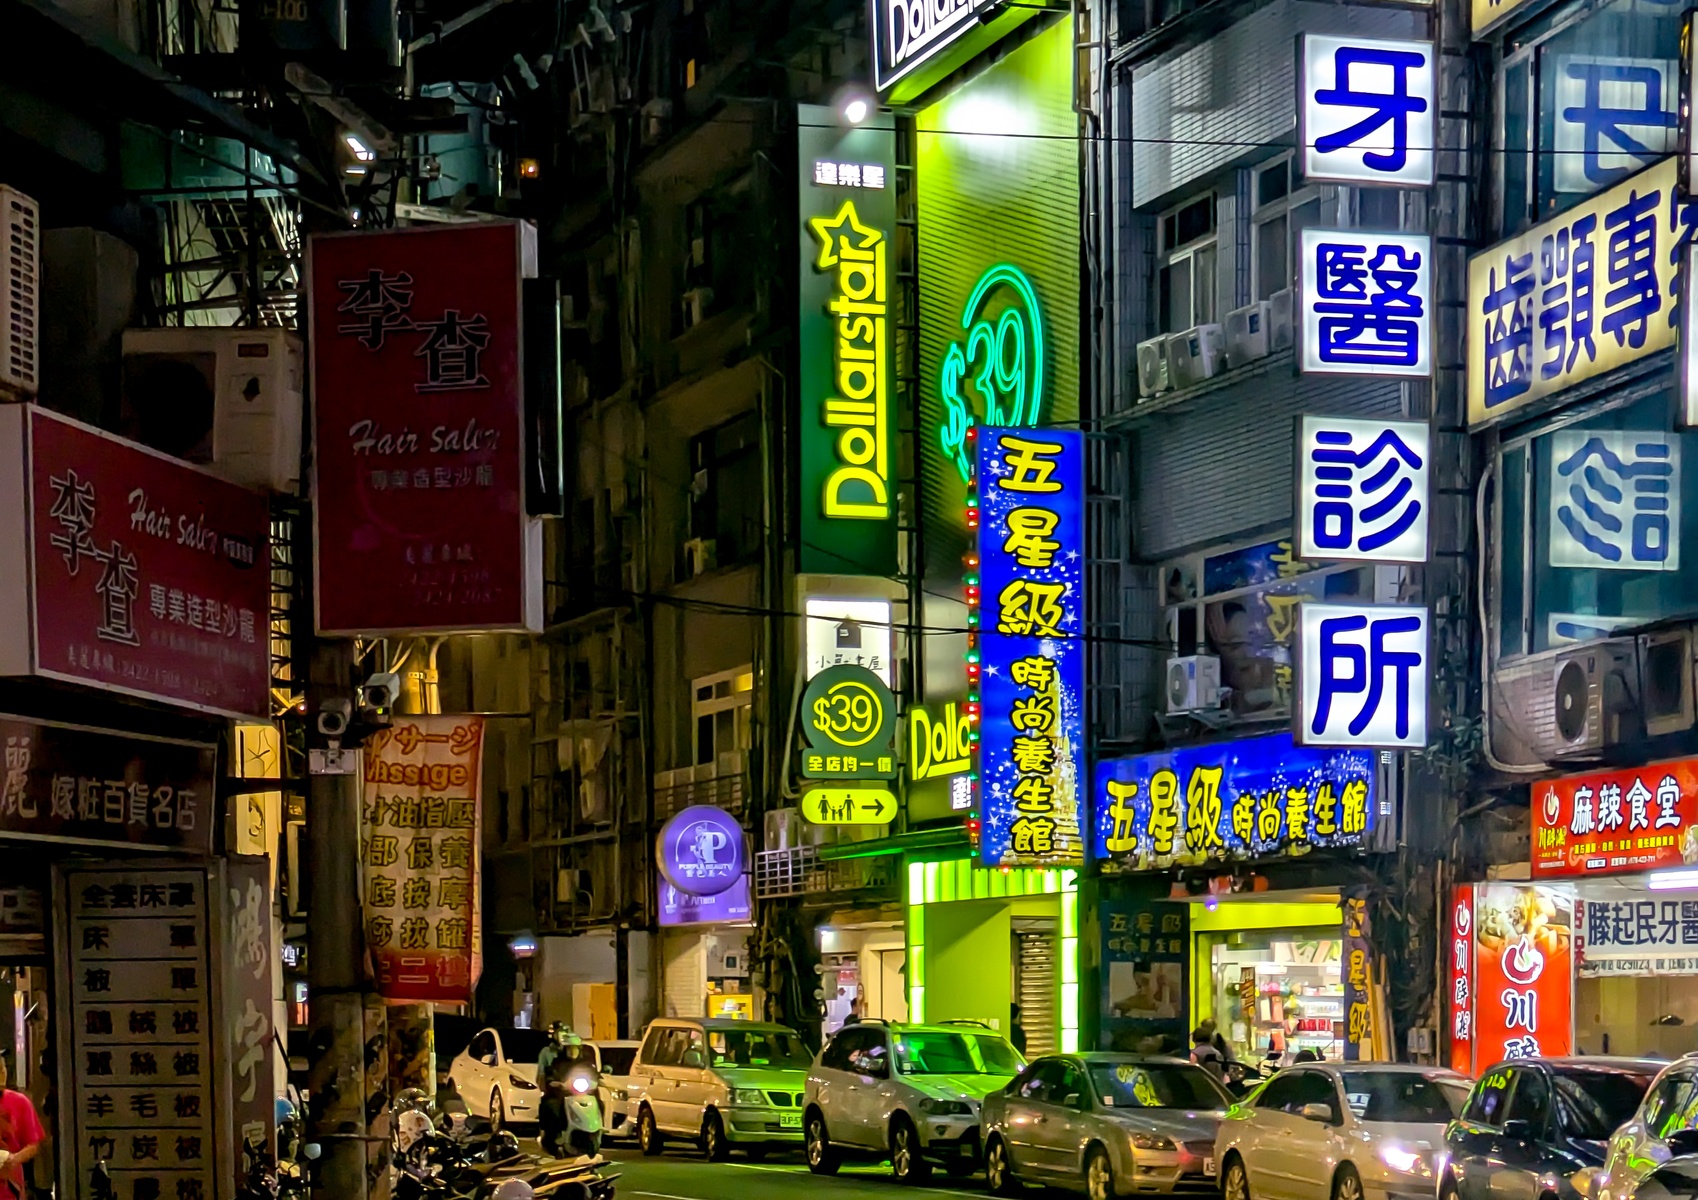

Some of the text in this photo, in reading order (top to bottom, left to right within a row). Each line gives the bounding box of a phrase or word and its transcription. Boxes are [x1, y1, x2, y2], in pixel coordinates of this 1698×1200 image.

[338, 269, 492, 393] 李查
[818, 201, 889, 519] Dollarstar
[942, 308, 1026, 459] $39
[349, 418, 418, 456] Hair
[128, 488, 170, 538] Hair
[50, 468, 140, 647] 李查
[149, 583, 256, 644] 專業造型沙龍
[814, 695, 873, 732] $39
[808, 755, 892, 773] 全店均一價
[362, 796, 475, 828] 油指壓
[1571, 776, 1681, 834] 麻辣食堂
[361, 835, 470, 869] 部保養
[81, 882, 196, 909] 全套床罩
[87, 1094, 201, 1118] 羊毛被
[89, 1136, 201, 1160] 竹炭被
